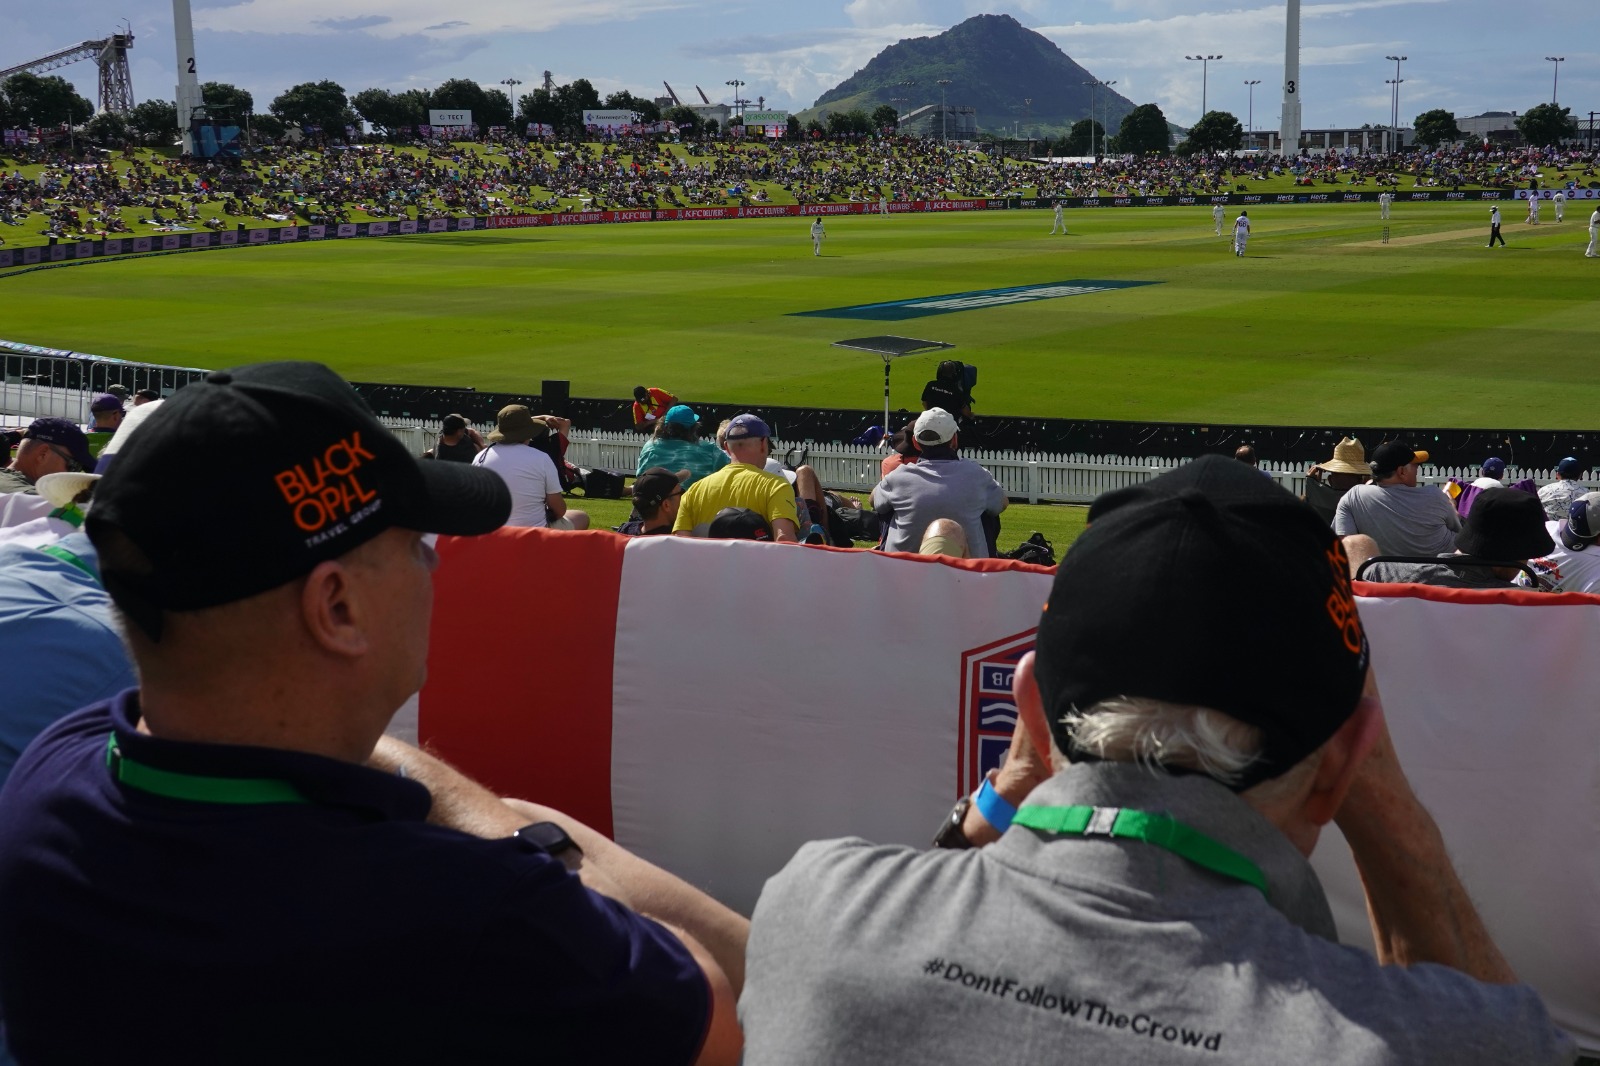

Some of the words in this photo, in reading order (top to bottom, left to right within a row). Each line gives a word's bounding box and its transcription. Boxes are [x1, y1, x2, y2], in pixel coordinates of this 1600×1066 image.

[187, 57, 196, 74] 2
[1287, 80, 1296, 94] 3
[745, 112, 785, 122] grassroots
[685, 209, 703, 218] KFC
[746, 207, 764, 215] KFC
[808, 205, 827, 213] KFC
[561, 214, 578, 222] KFC
[621, 212, 640, 220] KFC
[498, 217, 516, 226] KFC
[274, 431, 376, 504] BLACK
[294, 473, 377, 531] OPAL
[304, 523, 349, 548] TRAVEL
[923, 957, 1222, 1051] #DontFollowTheCrowd
